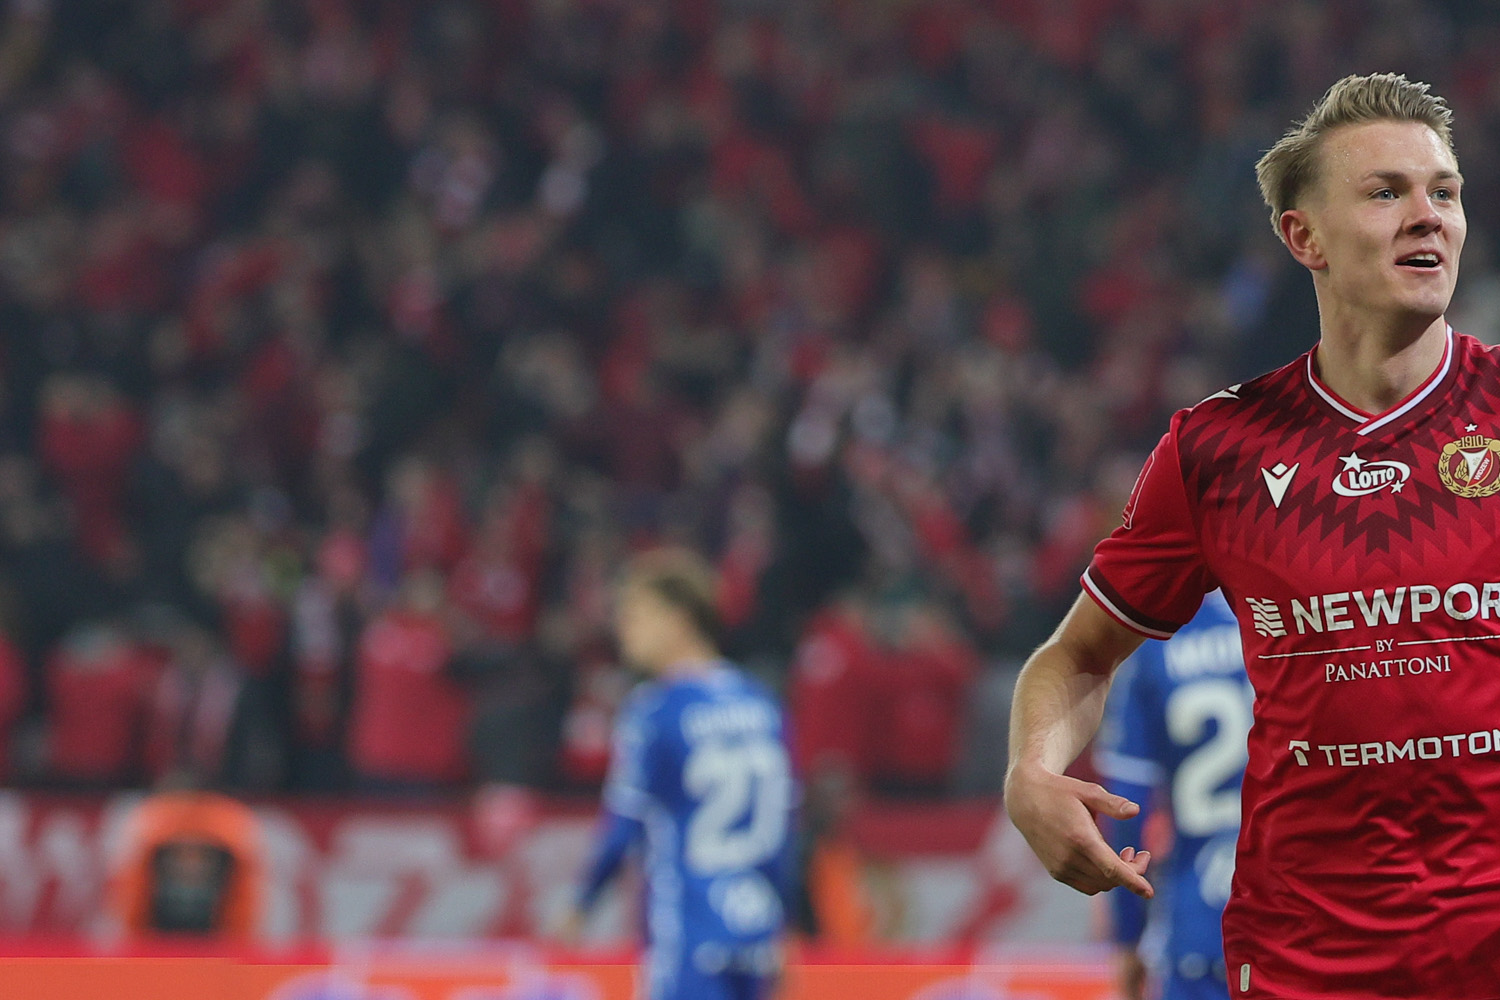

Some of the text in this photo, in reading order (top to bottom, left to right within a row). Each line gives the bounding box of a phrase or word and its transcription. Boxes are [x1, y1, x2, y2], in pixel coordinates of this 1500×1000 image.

[1460, 434, 1484, 448] 1910
[1348, 467, 1396, 489] LOTTO
[1473, 457, 1491, 481] WIDZEW
[1376, 638, 1394, 652] BY
[1325, 655, 1451, 682] PANATTONI
[1166, 678, 1250, 836] 2
